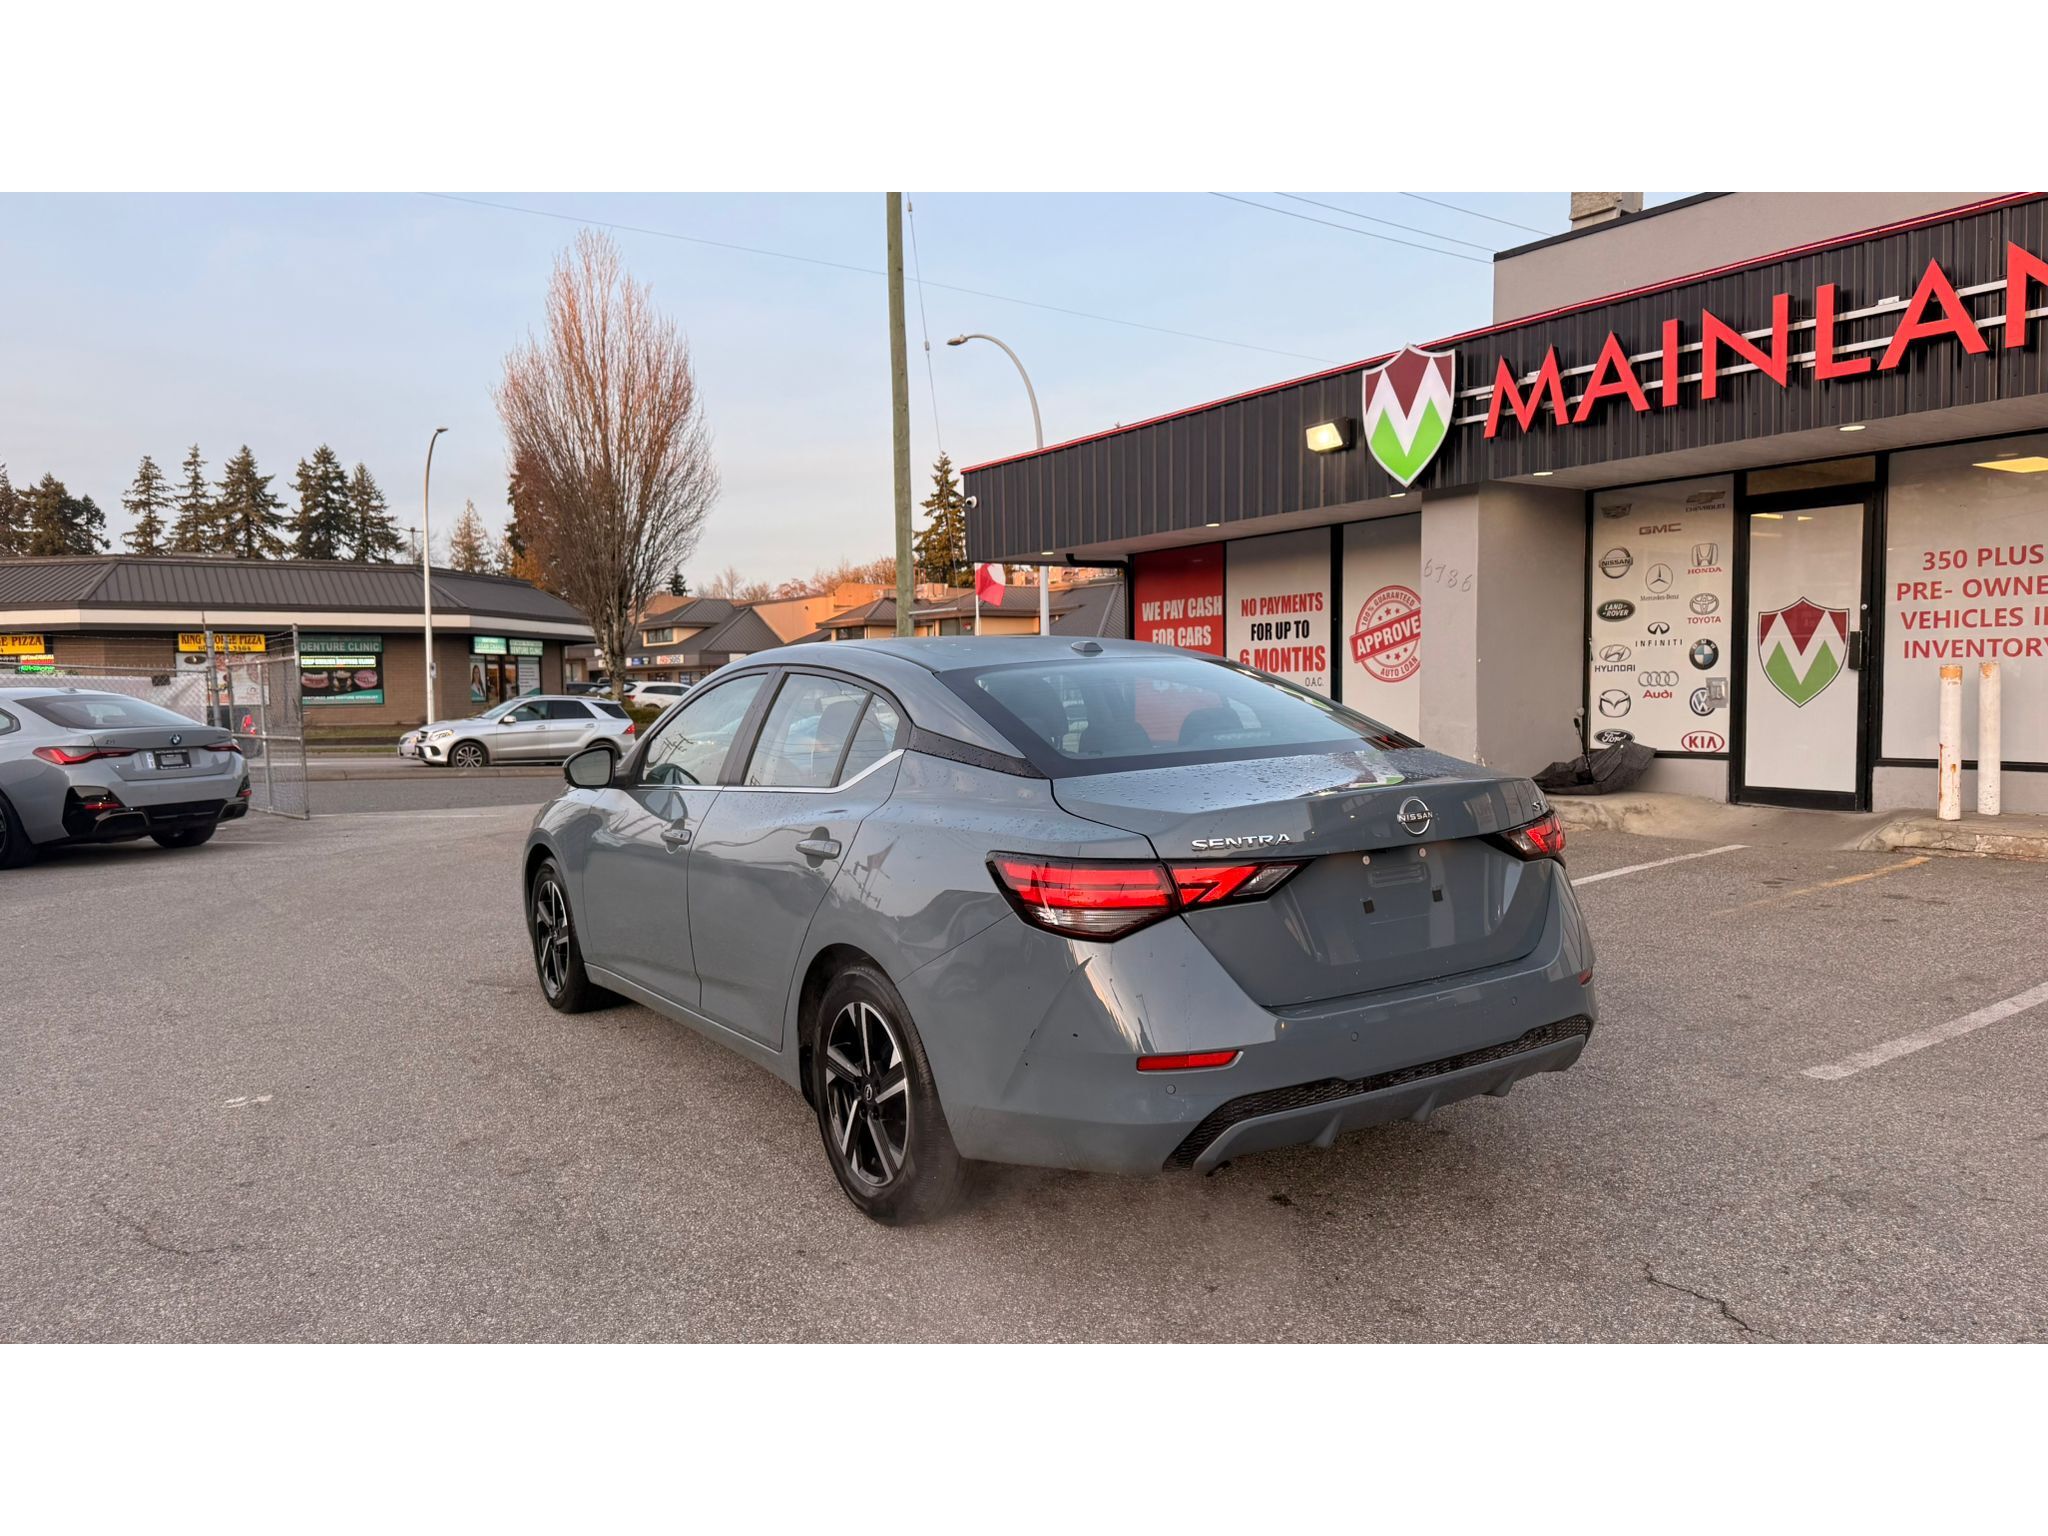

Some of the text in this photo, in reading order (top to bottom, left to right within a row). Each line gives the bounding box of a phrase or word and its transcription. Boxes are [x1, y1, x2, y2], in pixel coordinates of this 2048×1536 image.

[1639, 523, 1681, 536] GMC
[1601, 558, 1631, 566] NISSAN
[1922, 544, 2044, 571] 350 PLUS
[1423, 558, 1473, 593] 6786
[1687, 566, 1722, 575] HONDA
[1640, 593, 1680, 602] Mercedes-Benz
[1896, 581, 1952, 601] PRE-
[1142, 595, 1222, 622] WE PAY CASH
[1241, 592, 1324, 617] NO PAYMENTS
[1361, 591, 1415, 626] 100% GUARANTEED
[1606, 609, 1629, 617] ROVER
[1687, 616, 1722, 624] TOYOTA
[1901, 607, 2024, 630] VEHICLES
[1152, 625, 1212, 647] FOR CARS
[1250, 619, 1310, 641] FOR UP TO
[1357, 614, 1421, 656] APPROVE
[11, 635, 43, 647] PIZZA
[180, 634, 202, 646] KING
[239, 635, 262, 645] PIZZA
[300, 641, 379, 653] DENTURE CLINIC
[1635, 639, 1683, 647] INFINITI
[1239, 645, 1326, 673] 6 MONTHS
[1380, 655, 1418, 677] AUTO LOAN
[1594, 664, 1636, 673] HYUNDAI
[1642, 689, 1673, 699] Audi
[1688, 735, 1718, 749] KIA
[1398, 812, 1433, 823] NISSAN
[1191, 834, 1291, 852] SENTRA
